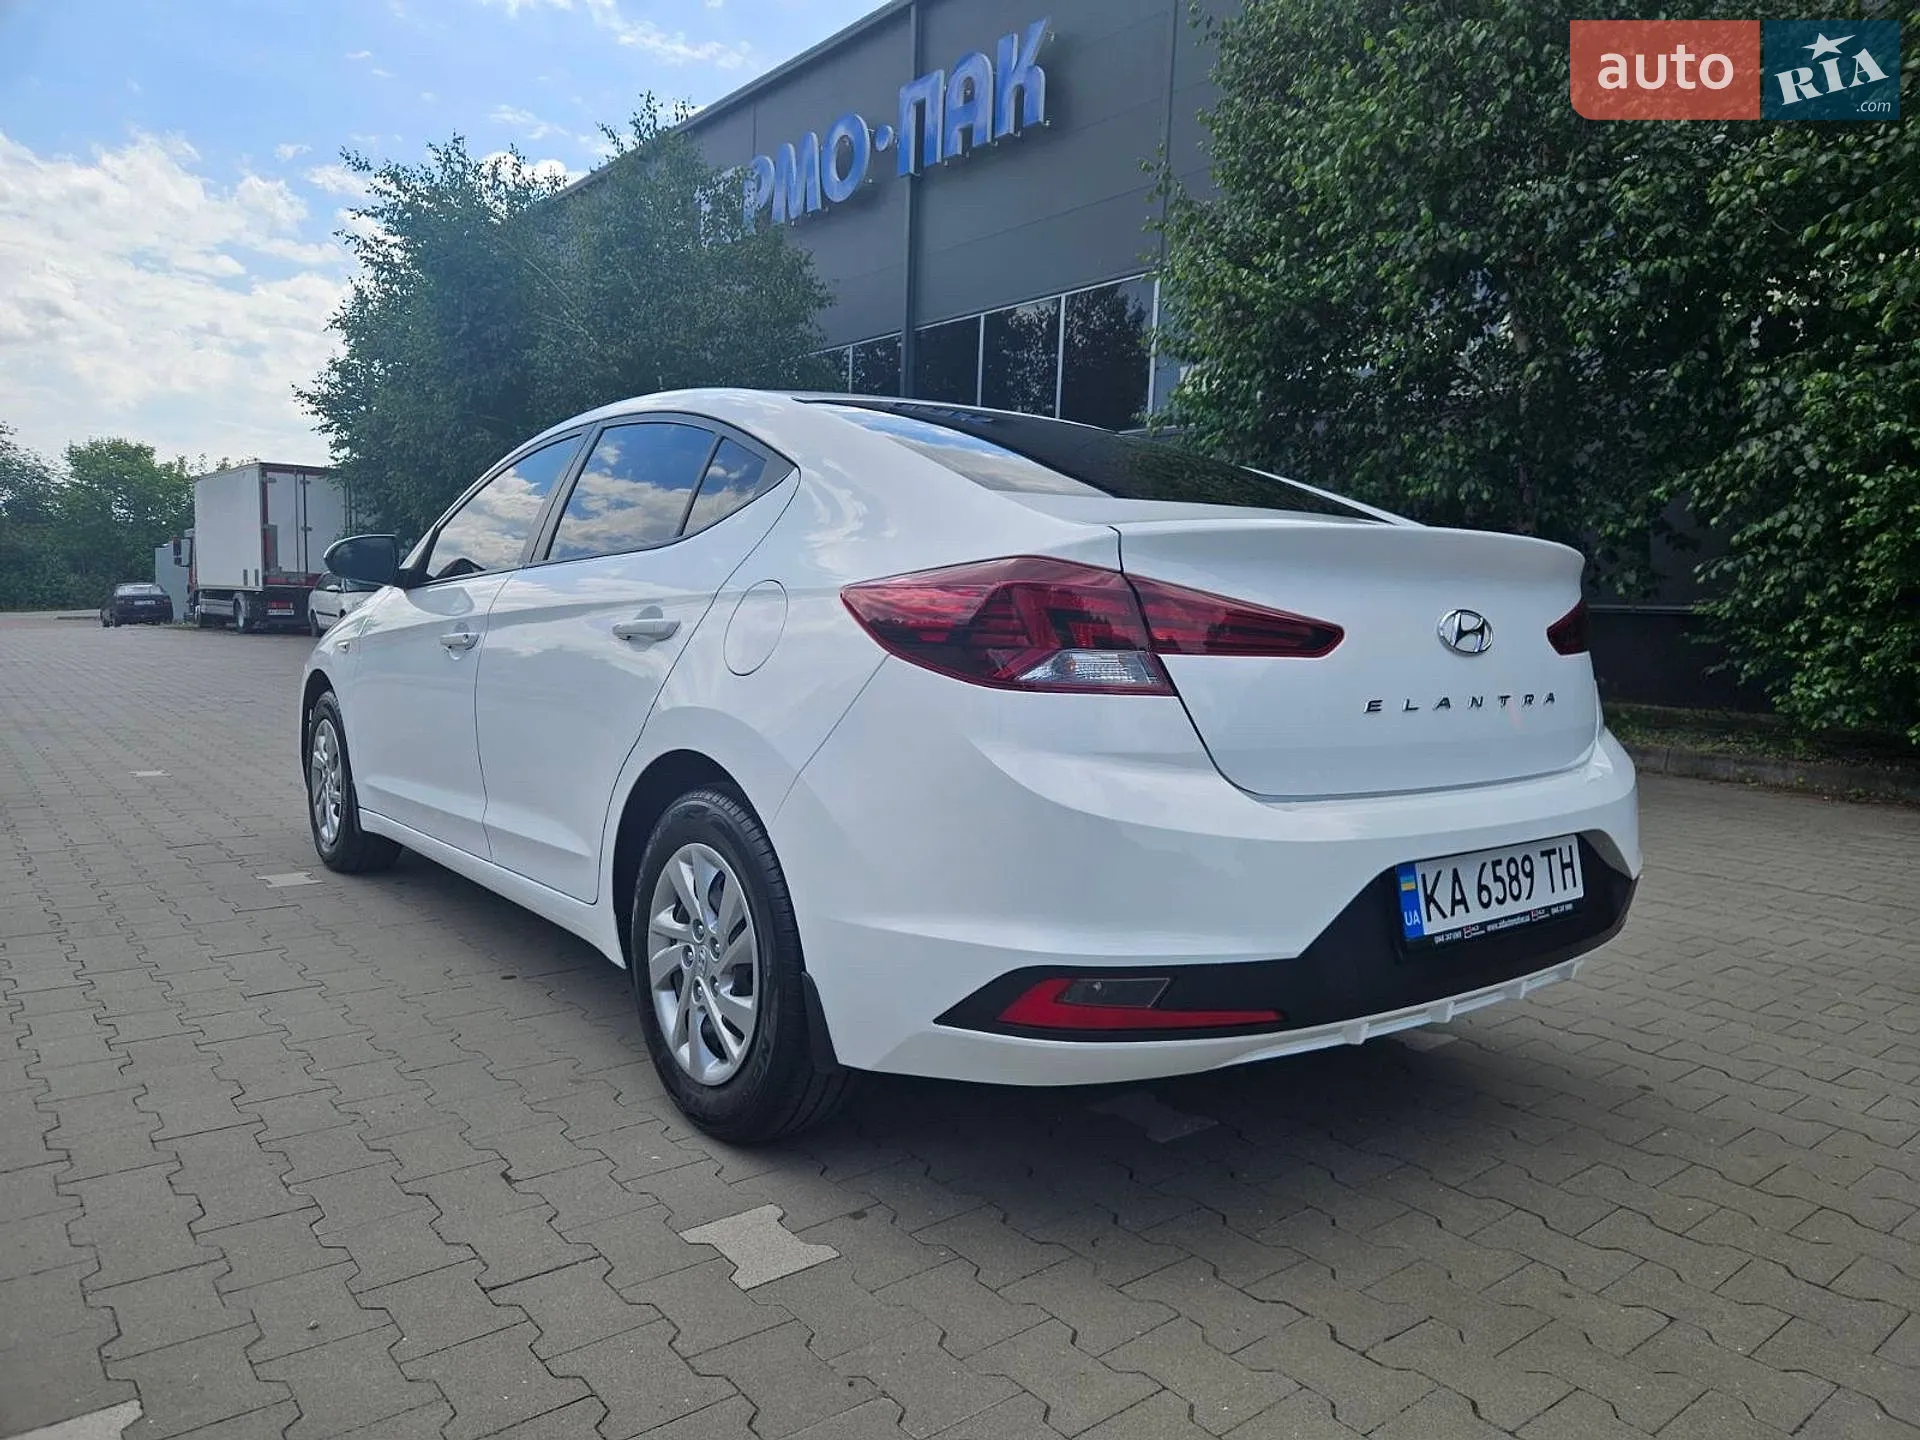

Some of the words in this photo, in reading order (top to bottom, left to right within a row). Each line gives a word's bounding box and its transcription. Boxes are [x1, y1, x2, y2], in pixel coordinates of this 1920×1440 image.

[1363, 692, 1556, 714] ELANTRA
[1404, 911, 1422, 927] UA
[1420, 867, 1470, 923] KA
[1477, 854, 1534, 910] 6589
[1540, 844, 1577, 894] TH
